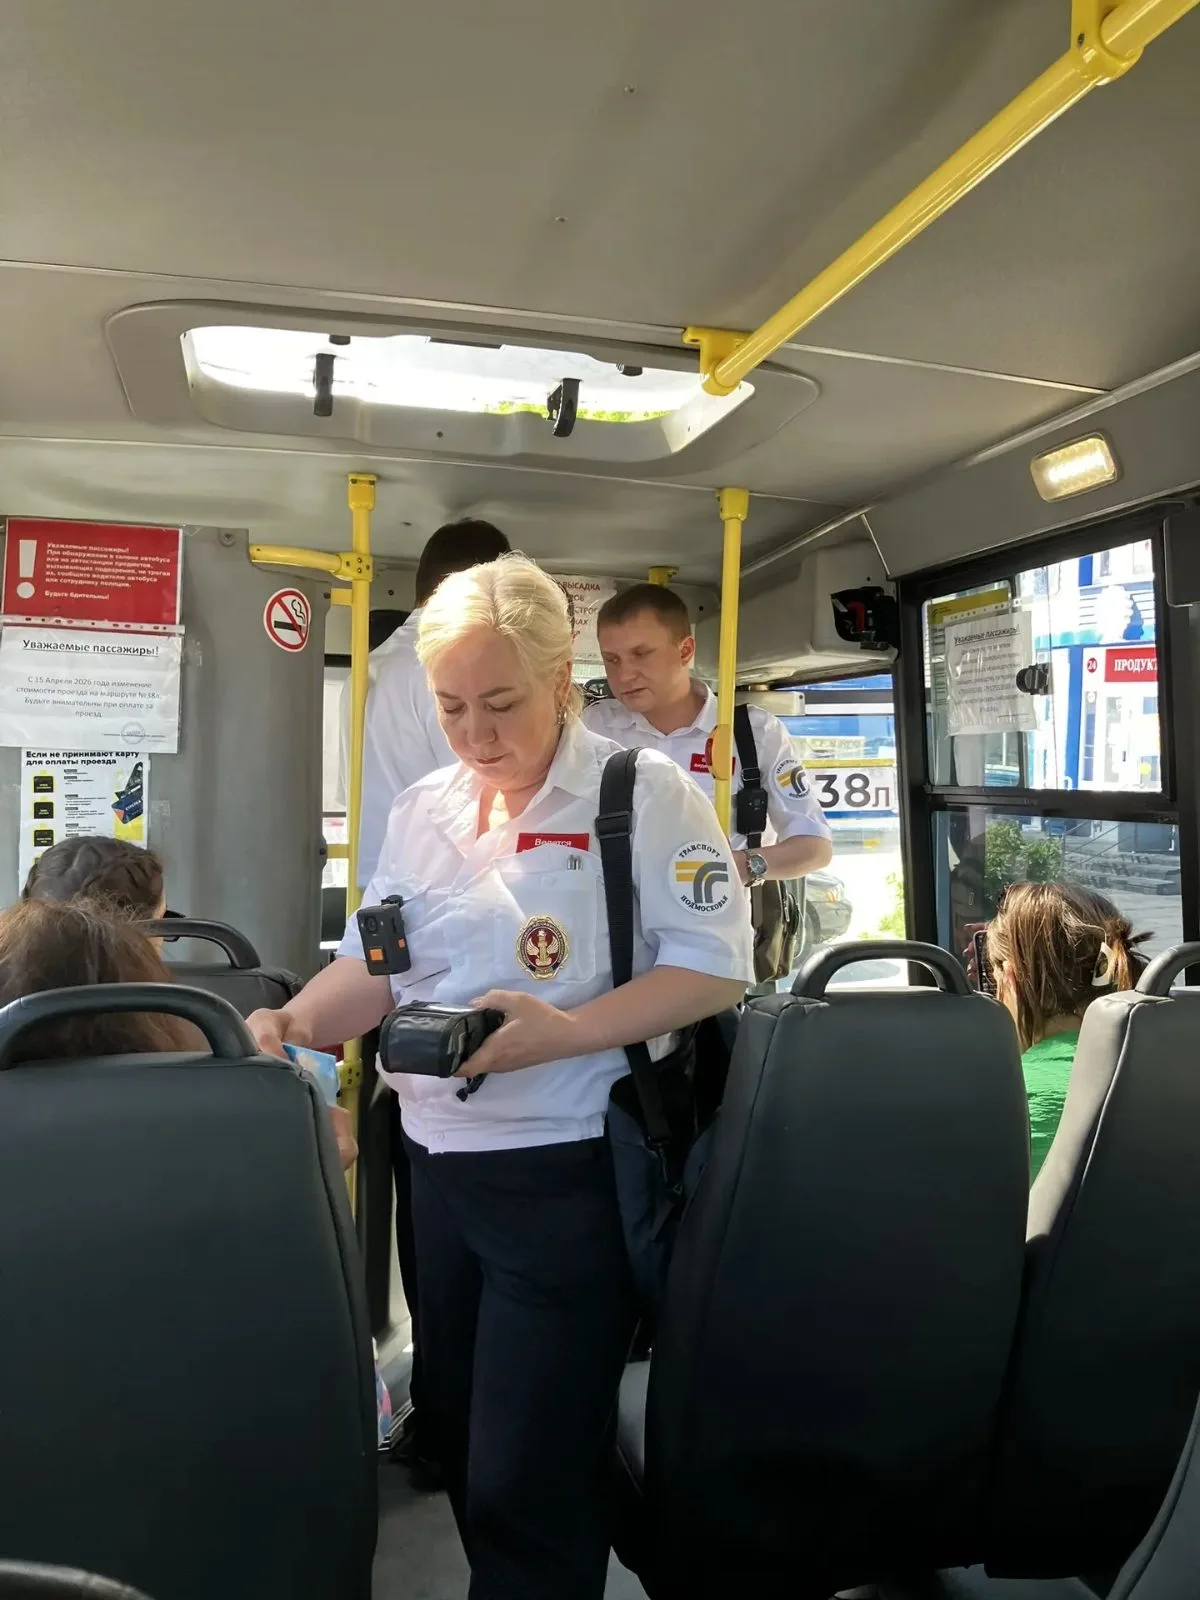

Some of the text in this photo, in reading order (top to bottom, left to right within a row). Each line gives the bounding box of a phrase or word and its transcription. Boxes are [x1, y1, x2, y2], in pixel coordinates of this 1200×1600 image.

[563, 581, 600, 591] ВЫСАДКА
[575, 606, 599, 615] СТРОГ
[23, 639, 159, 657] Уважаемые пассажиры!
[1087, 660, 1097, 670] 24
[80, 758, 117, 766] проезда
[679, 843, 721, 859] ТРАНСПОРТ
[680, 895, 729, 912] ПОДМОСКОВЬЯ
